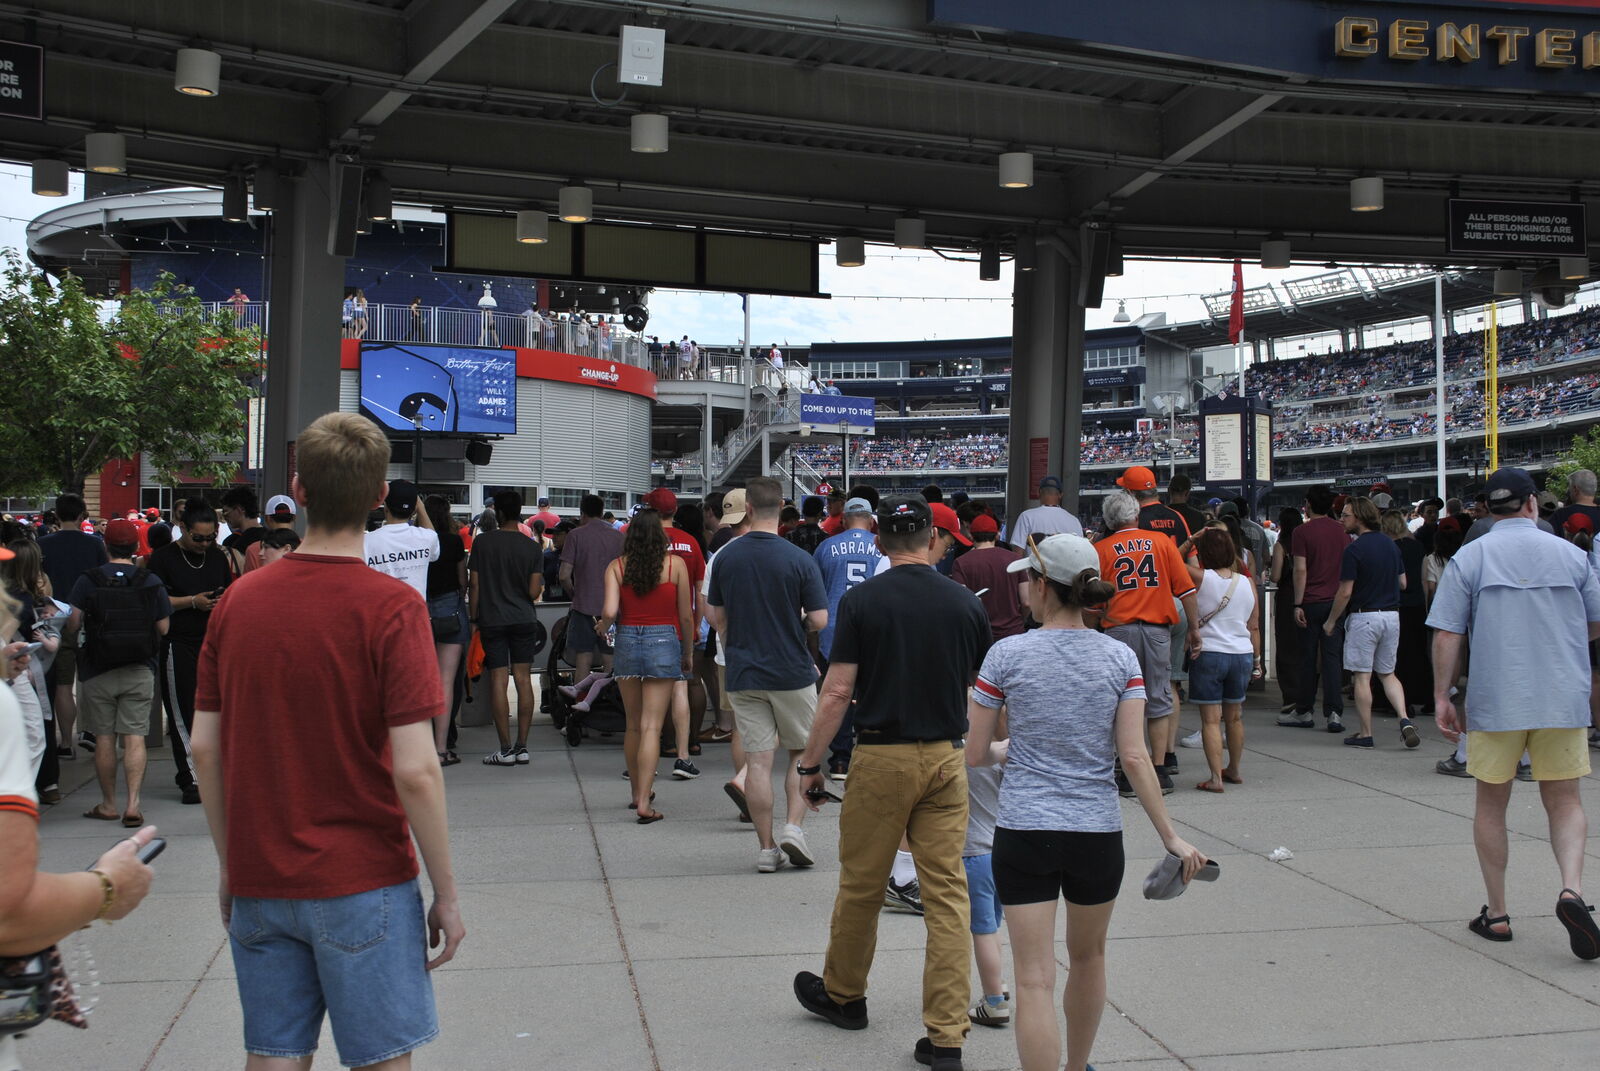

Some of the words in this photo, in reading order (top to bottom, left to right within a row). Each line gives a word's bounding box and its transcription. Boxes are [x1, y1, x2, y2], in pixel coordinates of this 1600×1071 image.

[1468, 213, 1486, 221] ALL
[1487, 214, 1530, 223] PERSONS
[1531, 215, 1568, 225] AND/OR
[1465, 222, 1492, 231] THEIR
[1493, 223, 1551, 233] BELONGINGS
[1553, 226, 1572, 234] ARE
[1463, 231, 1504, 240] SUBJECT
[1506, 233, 1519, 241] TO
[1520, 233, 1574, 243] INSPECTION
[581, 368, 619, 382] CHANGE-UP
[486, 387, 507, 395] WILLY
[478, 397, 507, 405] ADAMES
[803, 405, 824, 413] COME
[825, 406, 836, 414] ON
[837, 407, 847, 415] UP
[859, 408, 873, 416] THE
[1113, 538, 1152, 556] MAYS
[367, 548, 430, 567] ALLSAINTS
[846, 560, 867, 591] 5
[1114, 553, 1160, 592] 24
